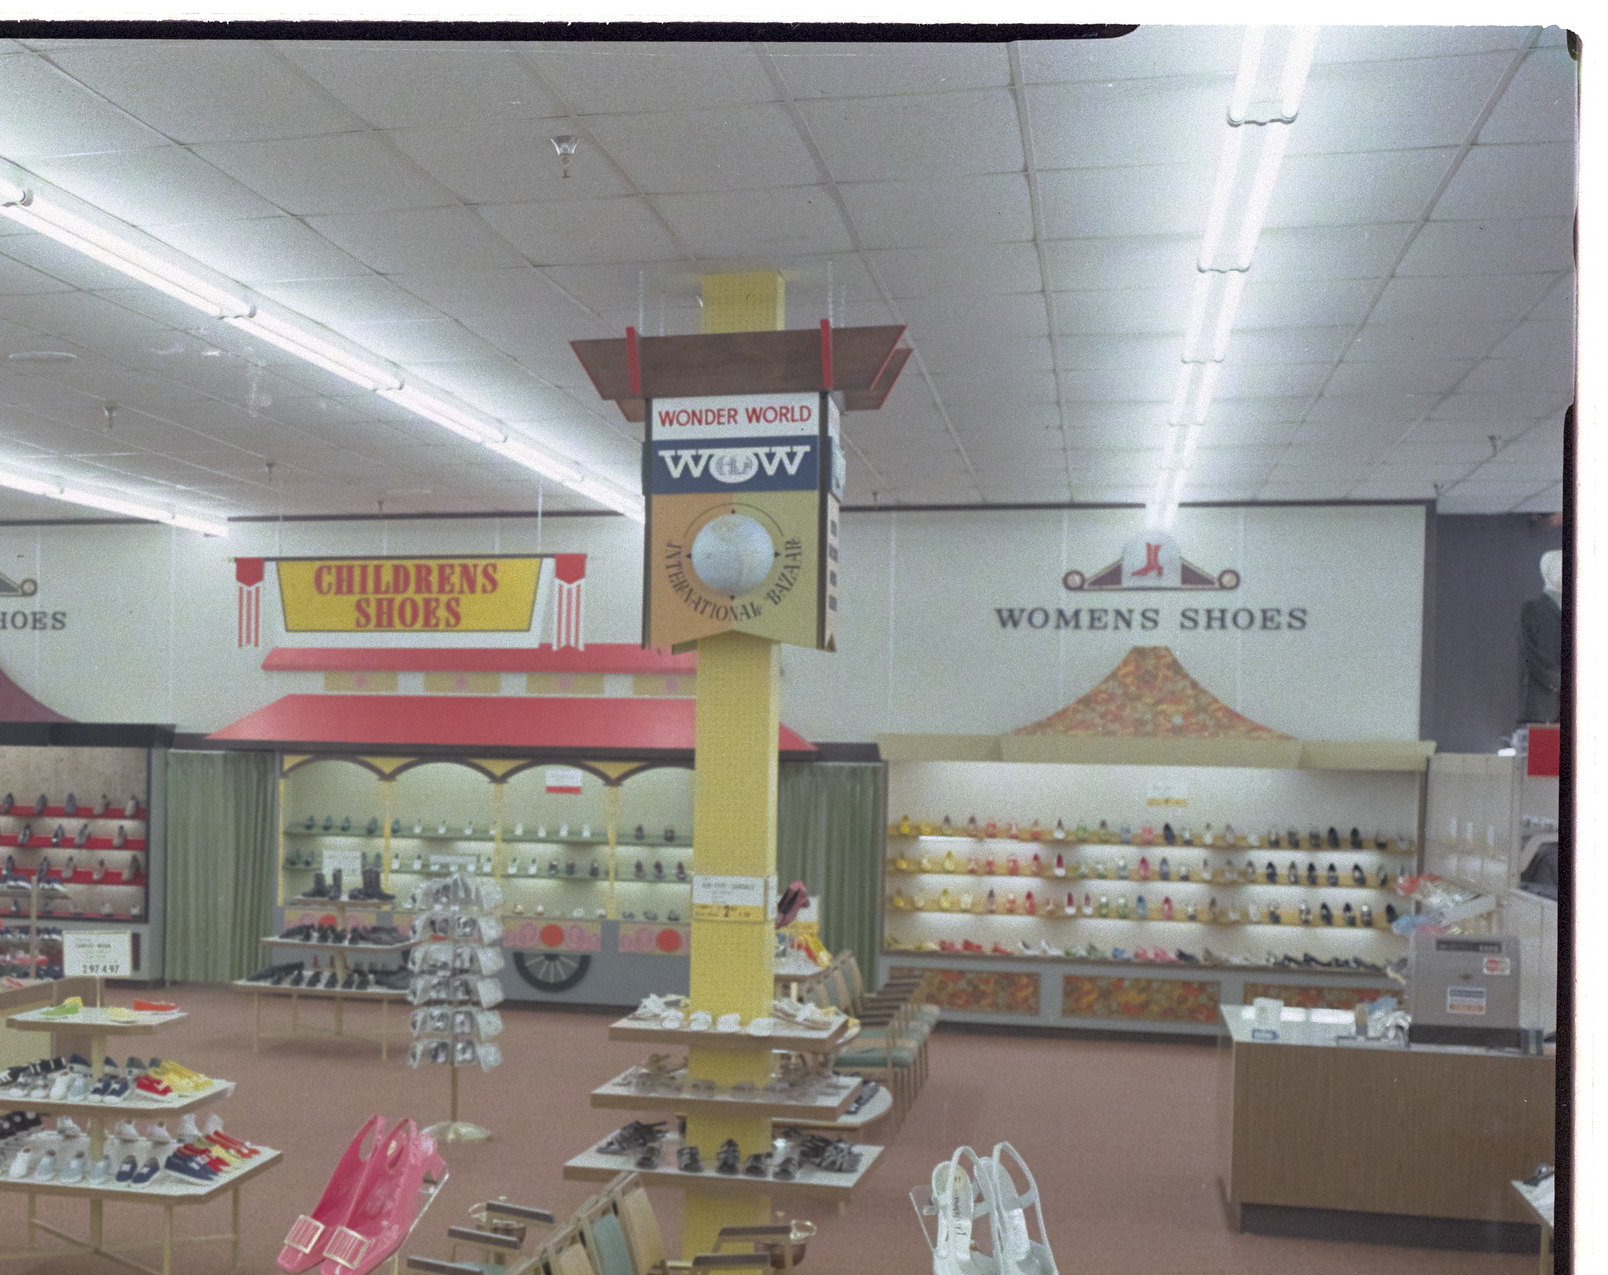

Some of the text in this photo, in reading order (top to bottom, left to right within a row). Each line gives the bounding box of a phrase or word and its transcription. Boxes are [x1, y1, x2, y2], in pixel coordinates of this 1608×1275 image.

[658, 405, 812, 427] WONDER WORLD
[313, 562, 500, 596] CHILDRENS
[665, 542, 762, 622] INTERNATIONAL
[766, 538, 802, 605] BAZAAR
[354, 597, 462, 629] SHOES
[994, 608, 1308, 631] WOMENS SHOES
